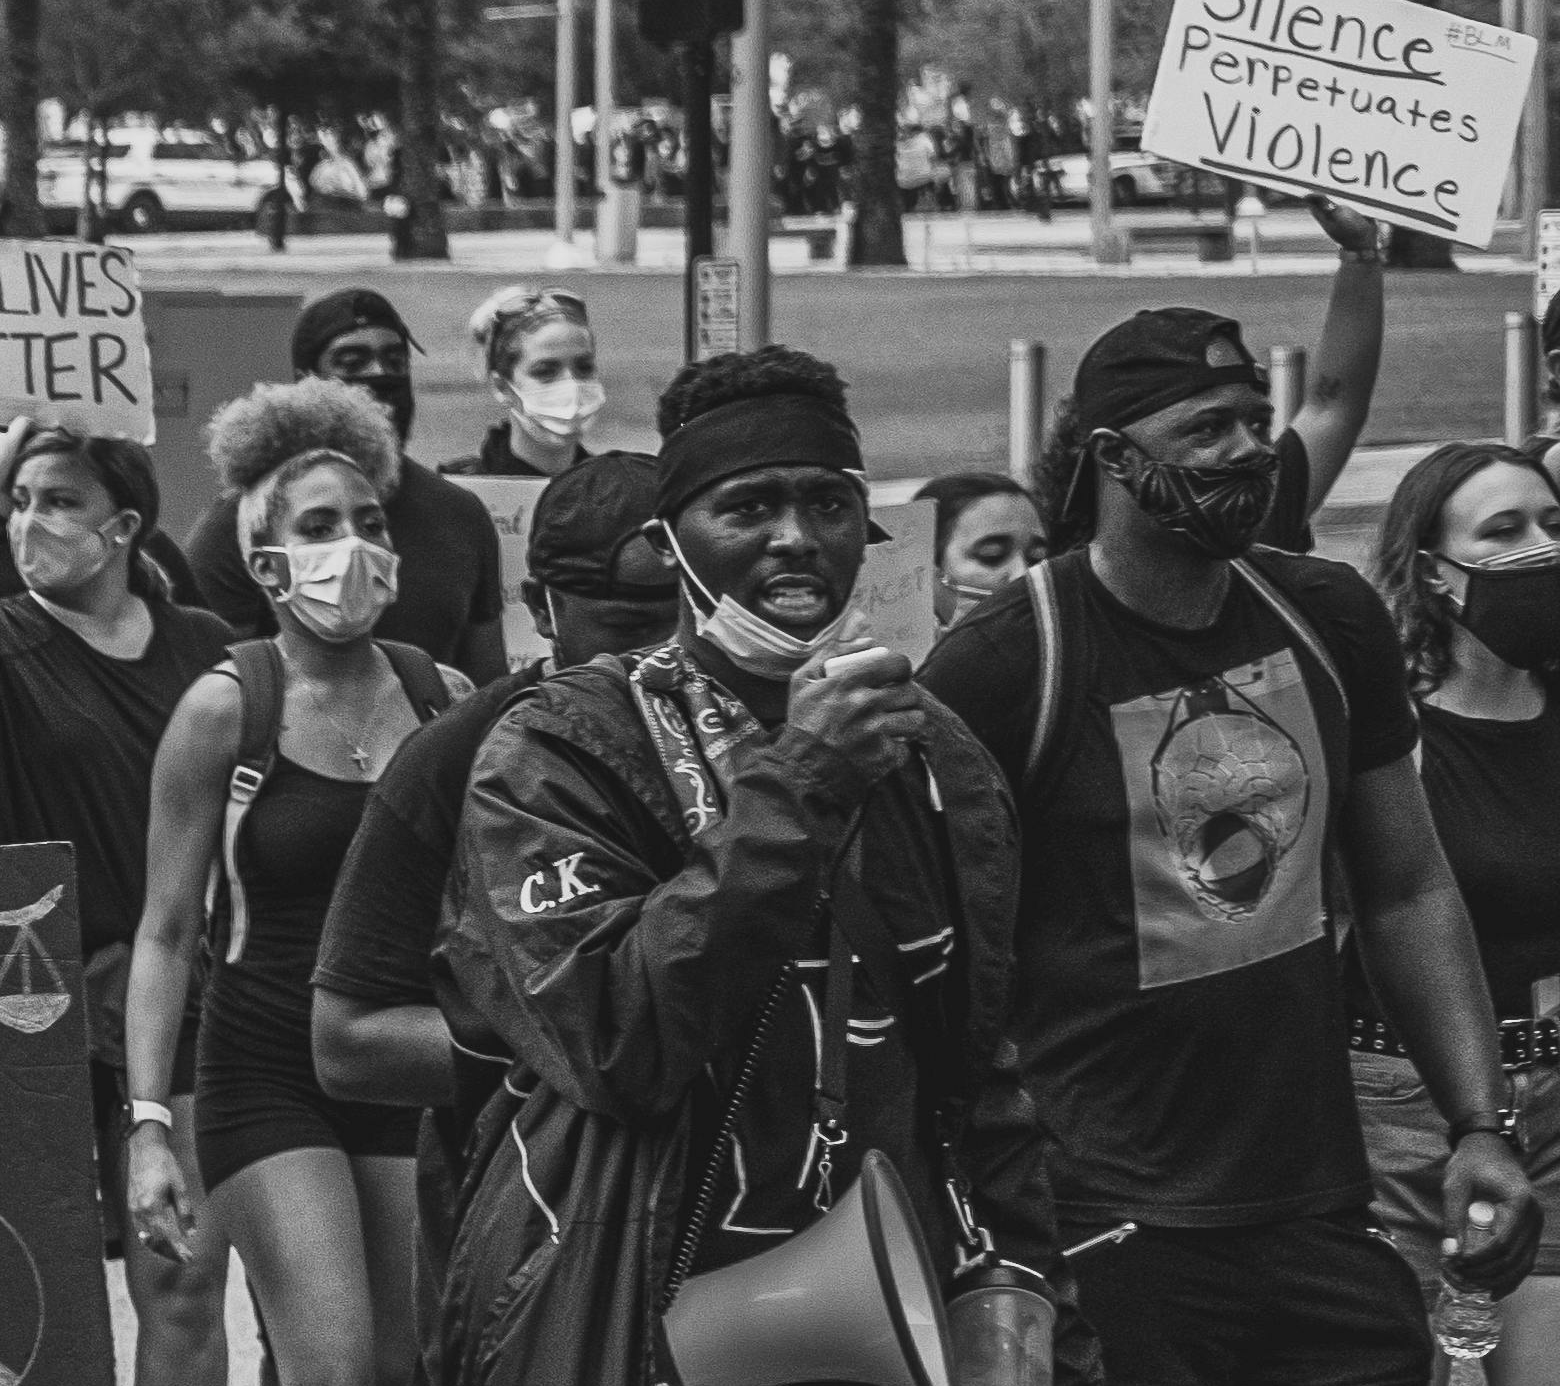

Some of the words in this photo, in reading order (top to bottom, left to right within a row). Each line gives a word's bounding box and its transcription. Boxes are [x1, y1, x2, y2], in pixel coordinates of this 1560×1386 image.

[1179, 24, 1480, 143] Perpetuates
[1203, 91, 1460, 217] Violence
[520, 851, 602, 915] C.K.
